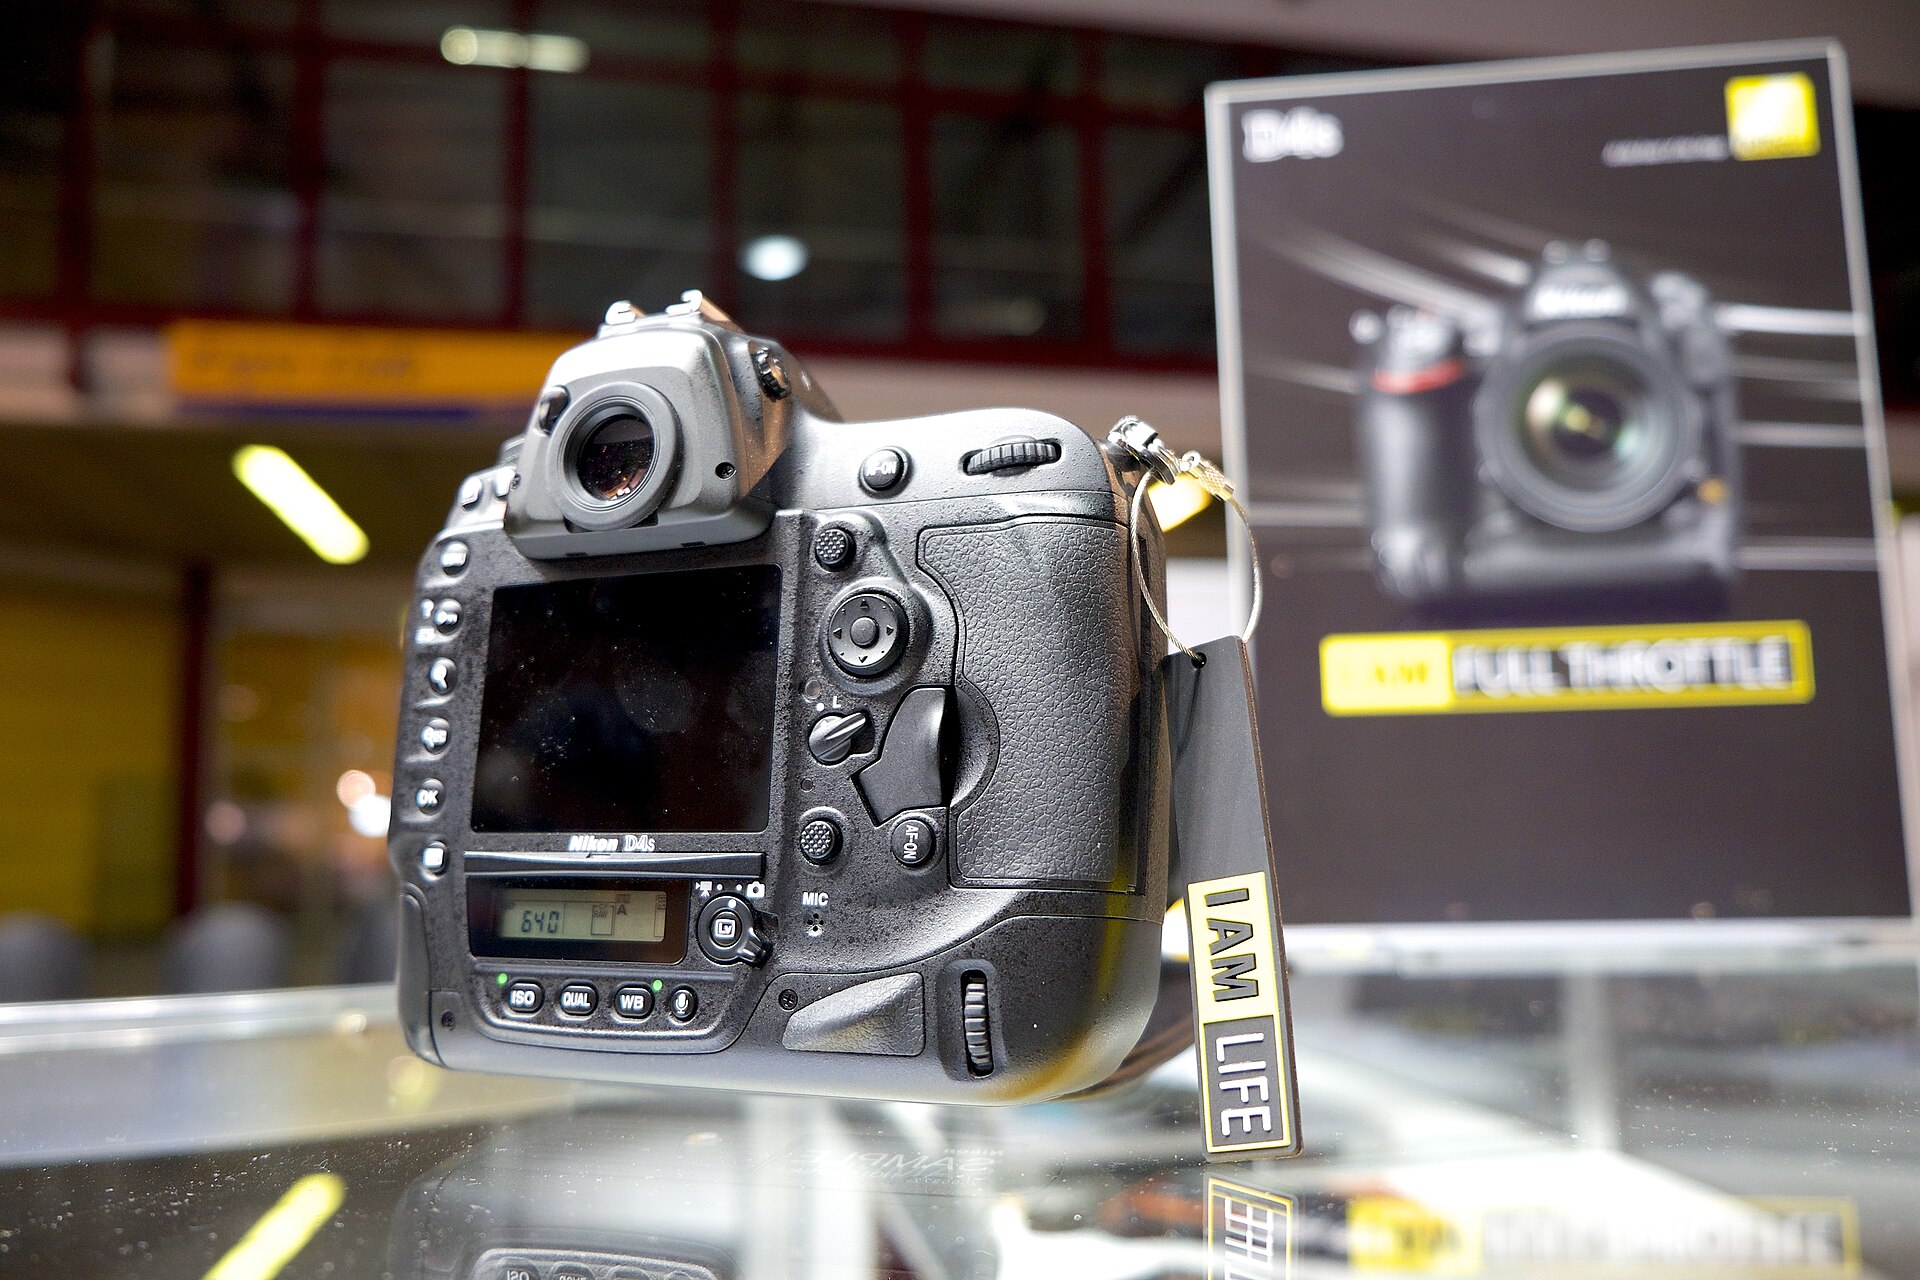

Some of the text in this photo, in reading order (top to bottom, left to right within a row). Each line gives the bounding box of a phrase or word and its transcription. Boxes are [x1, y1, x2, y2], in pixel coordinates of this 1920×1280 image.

[1453, 642, 1564, 698] FULL
[1559, 635, 1794, 694] THROTTLE
[416, 789, 439, 808] OK
[568, 835, 655, 852] Nikon D4s
[903, 825, 918, 860] AF-ON
[802, 892, 829, 906] MIC
[521, 910, 561, 934] 640
[511, 991, 536, 1004] ISO
[562, 992, 591, 1007] QUAL
[620, 995, 644, 1009] WB
[1204, 888, 1272, 1137] I AM LIFE
